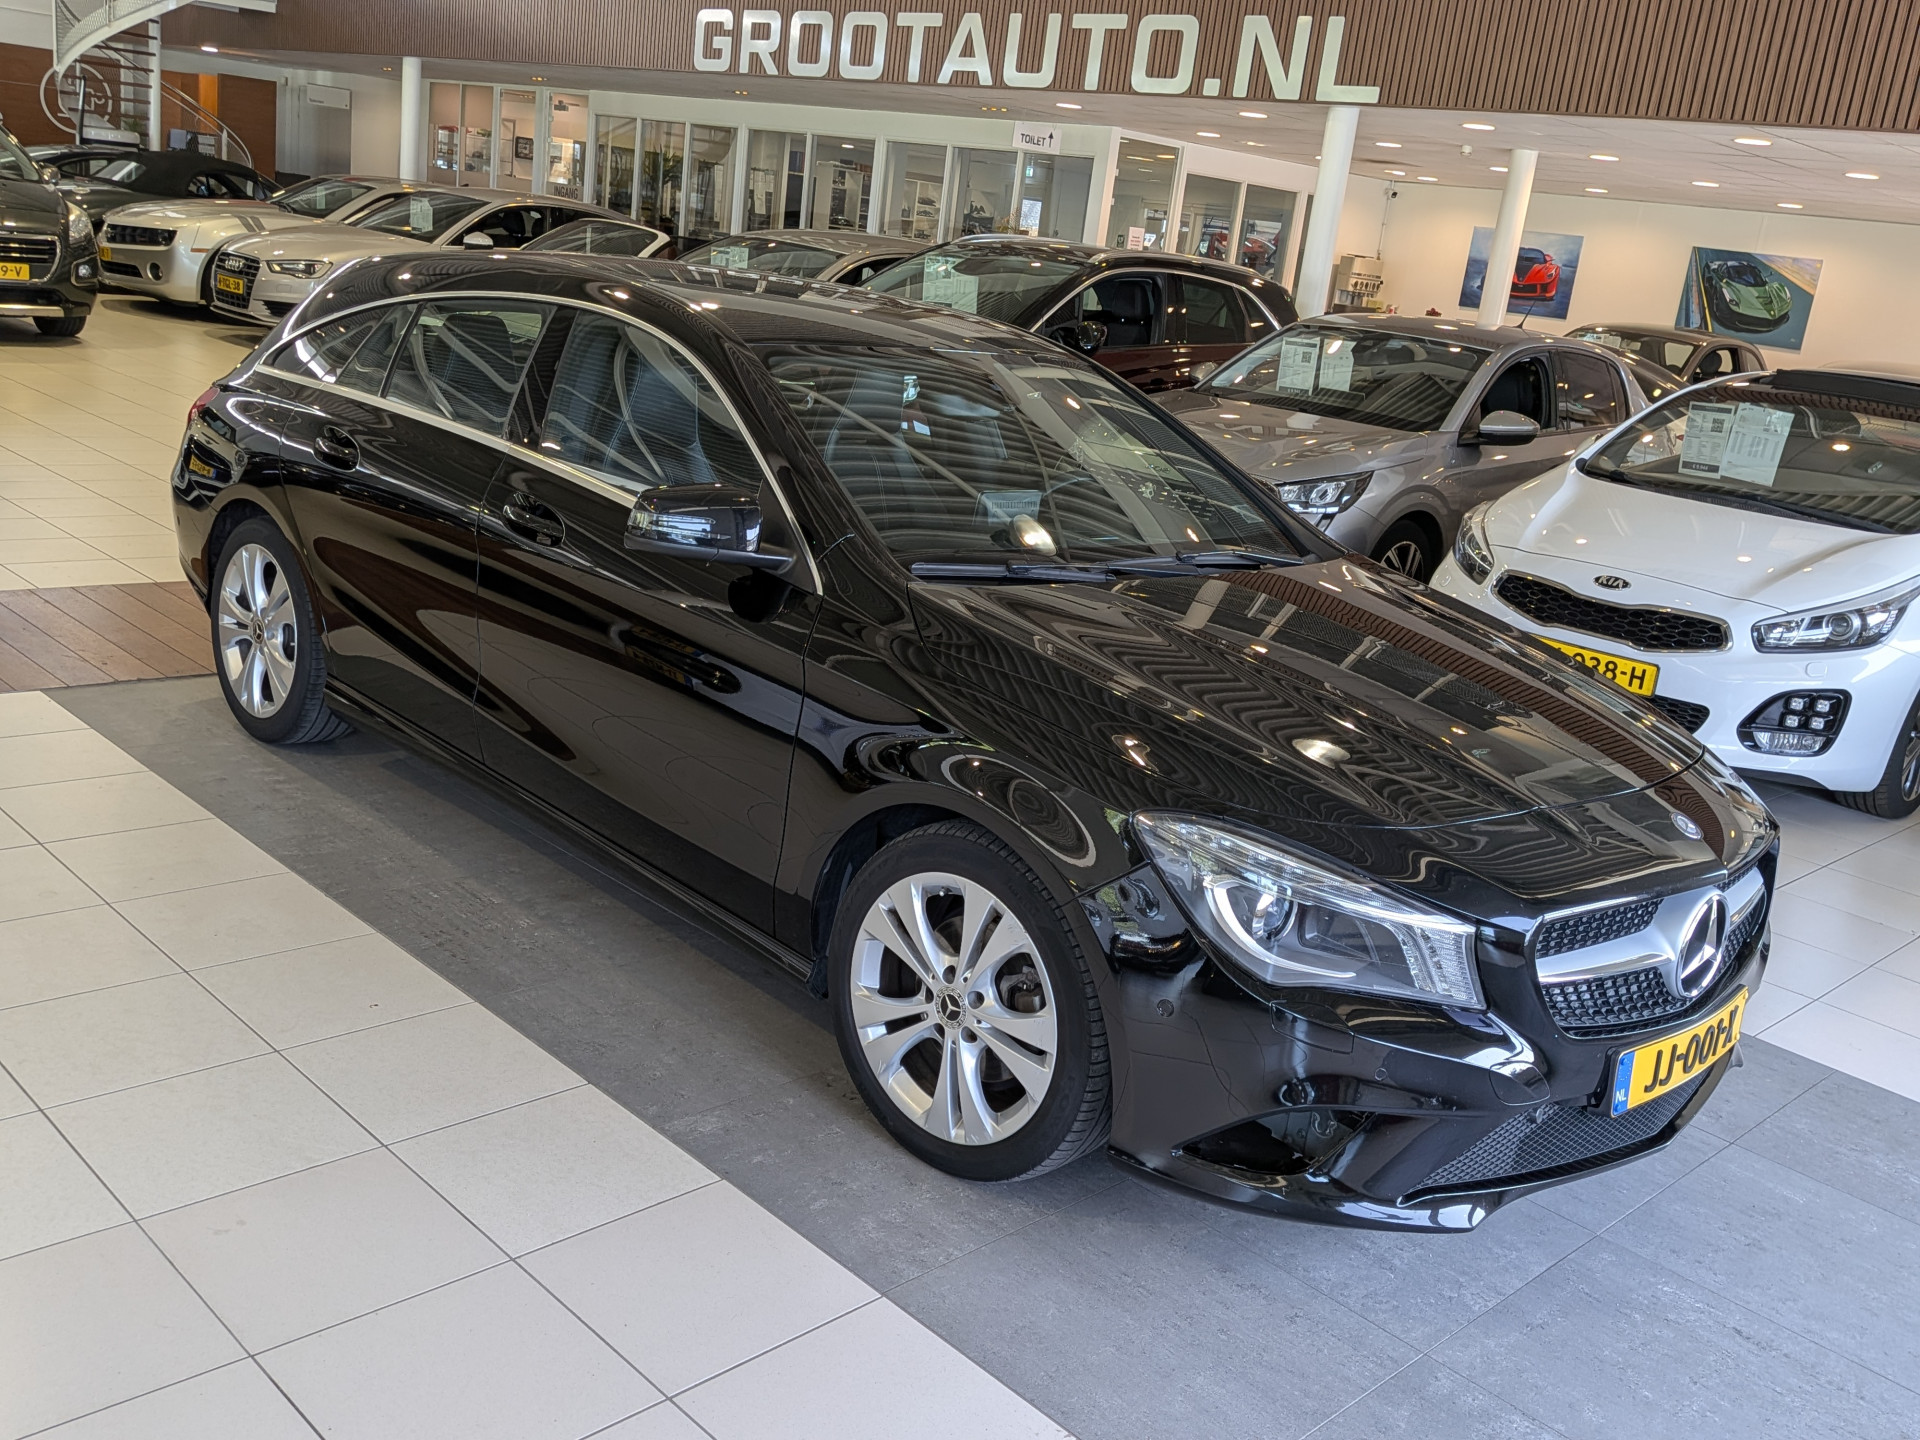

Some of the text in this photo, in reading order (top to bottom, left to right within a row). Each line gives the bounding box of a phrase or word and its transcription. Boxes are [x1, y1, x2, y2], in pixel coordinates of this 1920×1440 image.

[693, 8, 1381, 104] GROOTAUTO.NL
[1020, 132, 1047, 147] TOILET
[553, 185, 579, 200] INGANG
[1598, 576, 1623, 589] KIA
[1643, 1004, 1740, 1093] JJ-001-X
[1615, 1089, 1627, 1103] NL
